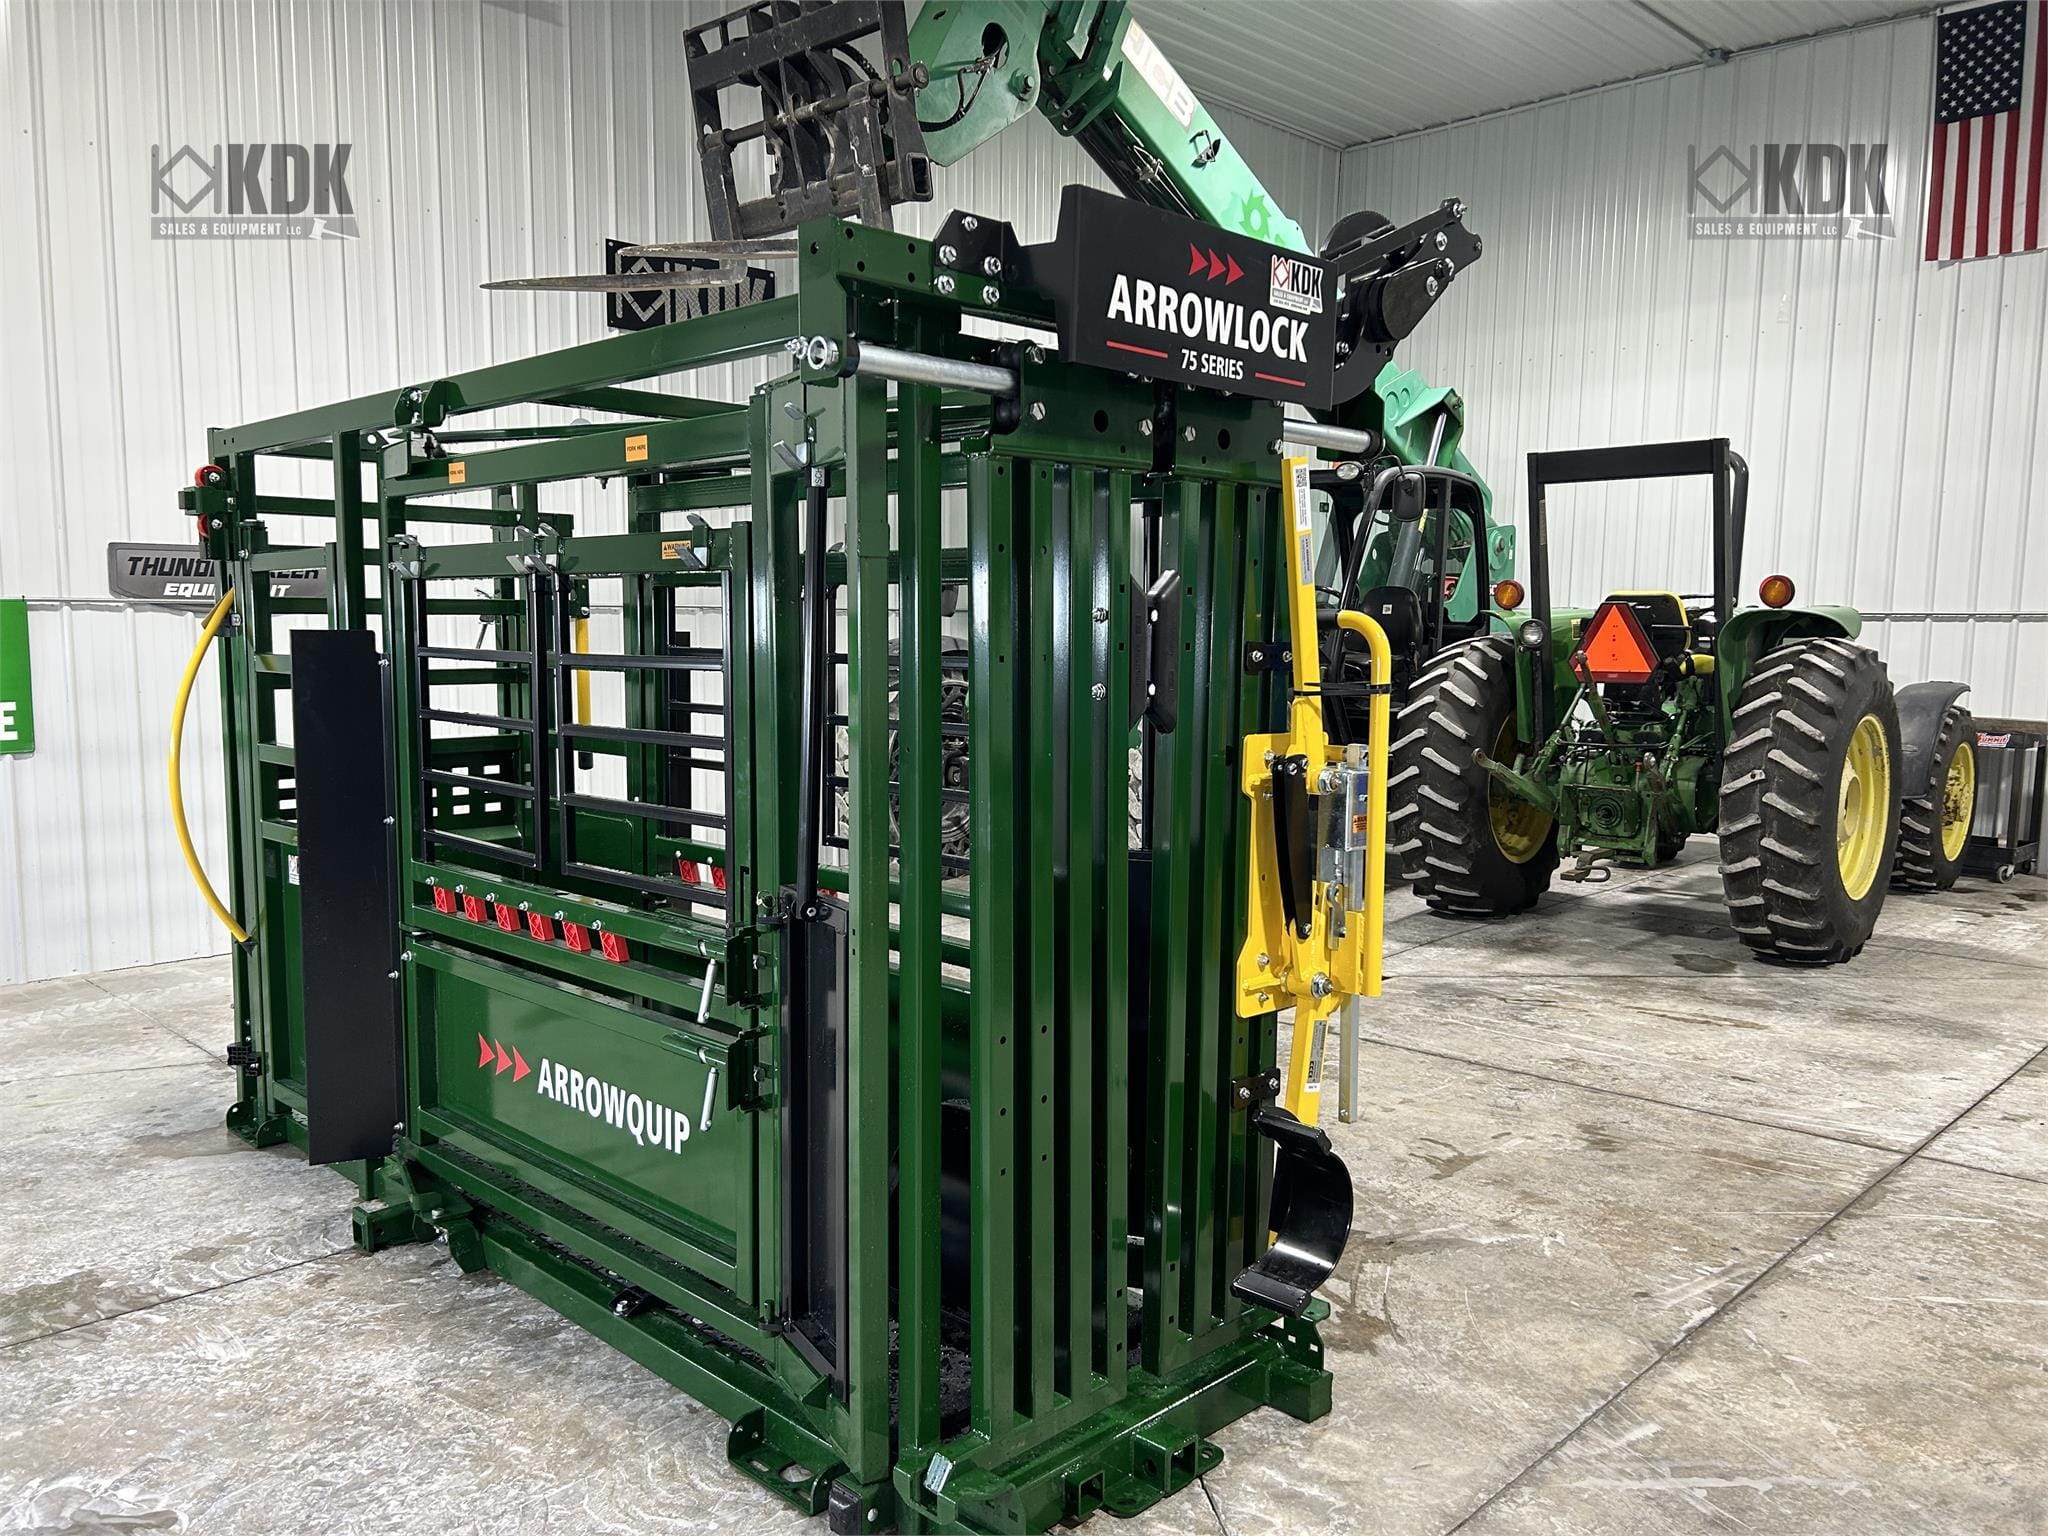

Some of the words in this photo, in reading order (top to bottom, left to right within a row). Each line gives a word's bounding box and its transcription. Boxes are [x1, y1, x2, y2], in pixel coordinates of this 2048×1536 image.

[1290, 261, 1322, 299] KDK
[1107, 273, 1309, 363] ARROWLOCK
[1181, 348, 1198, 371] 75
[1201, 353, 1244, 381] SERIES
[537, 1057, 691, 1155] ARROWQUIP
